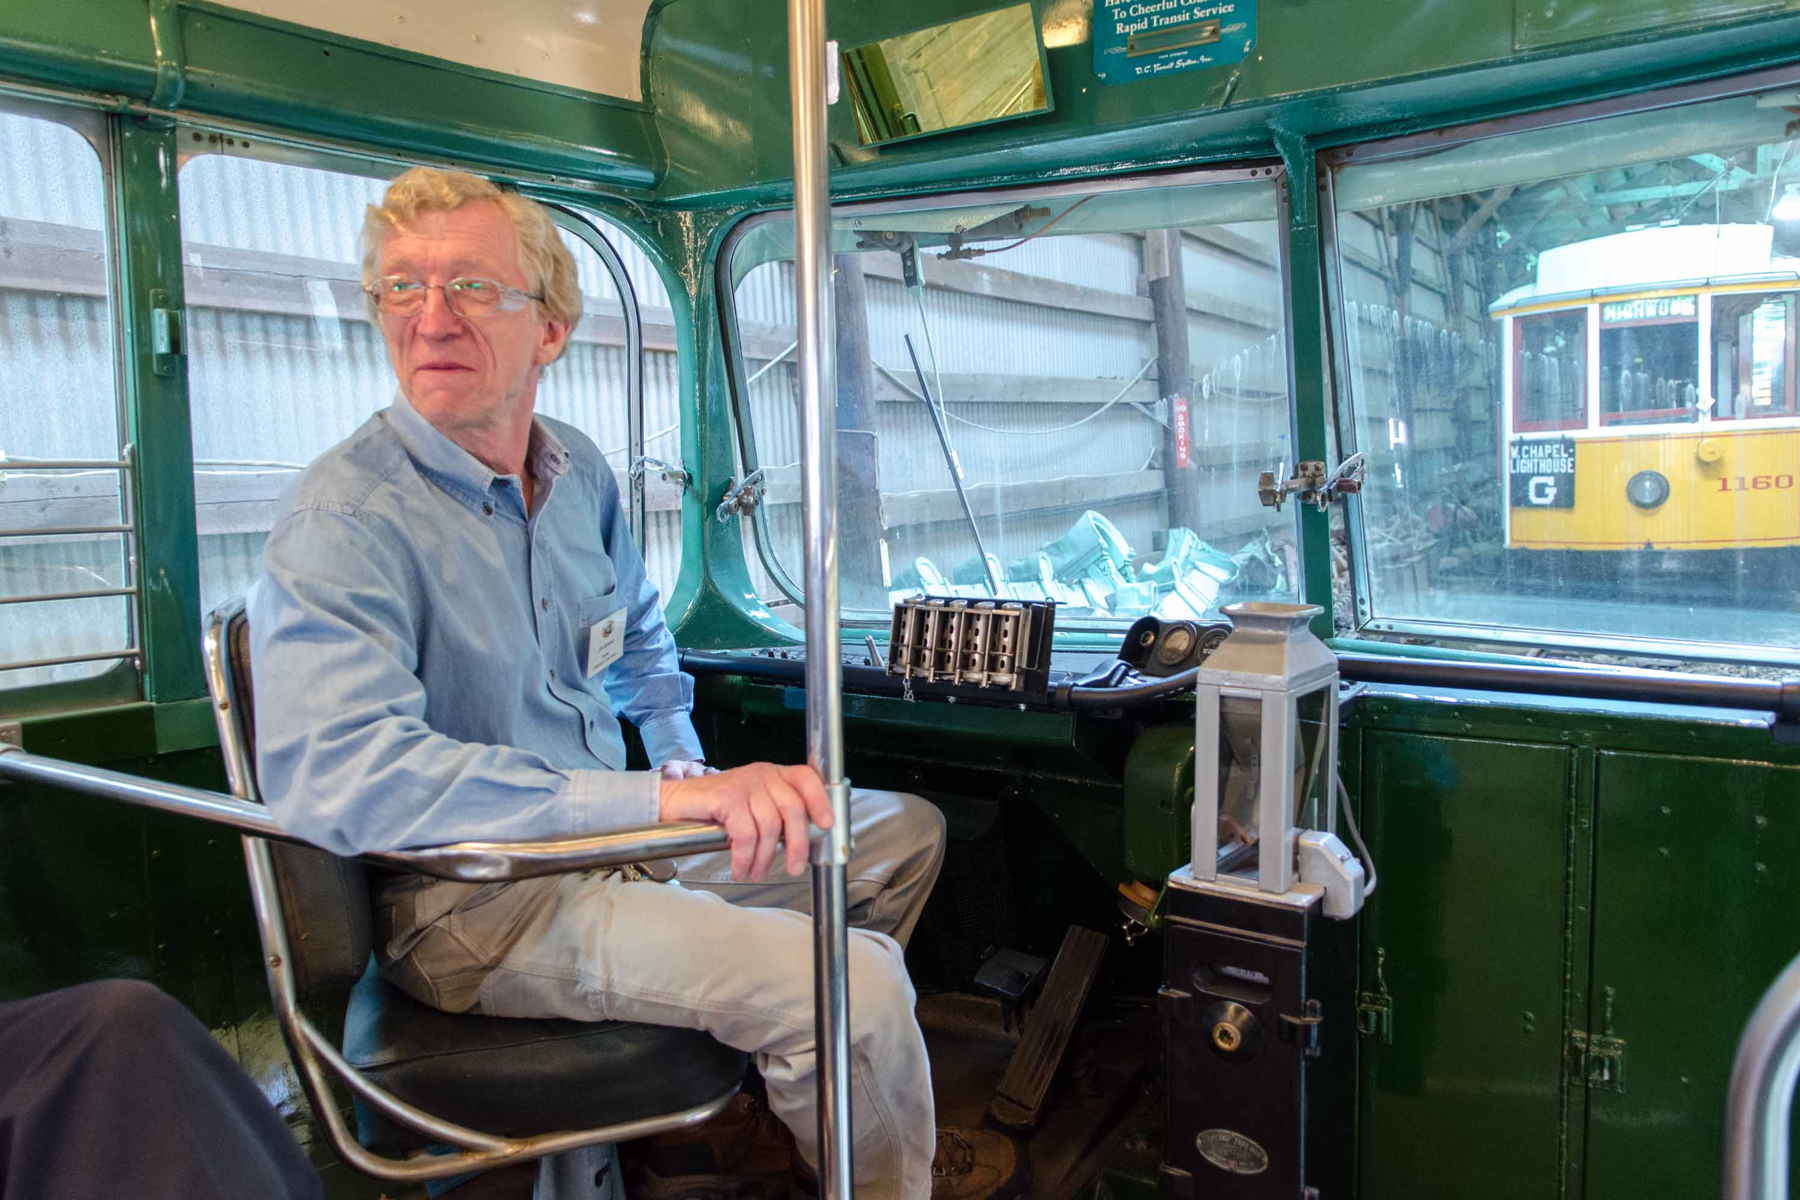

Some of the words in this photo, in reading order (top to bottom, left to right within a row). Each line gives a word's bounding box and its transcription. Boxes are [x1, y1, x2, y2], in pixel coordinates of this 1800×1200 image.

[1112, 8, 1127, 20] To
[1129, 0, 1177, 16] Cheerful
[1116, 17, 1148, 34] Rapid
[1151, 10, 1190, 27] Transit
[1193, 2, 1235, 19] Service
[1511, 457, 1575, 473] LIGHTHOUSE
[1528, 476, 1557, 505] G
[1716, 474, 1794, 492] 1160
